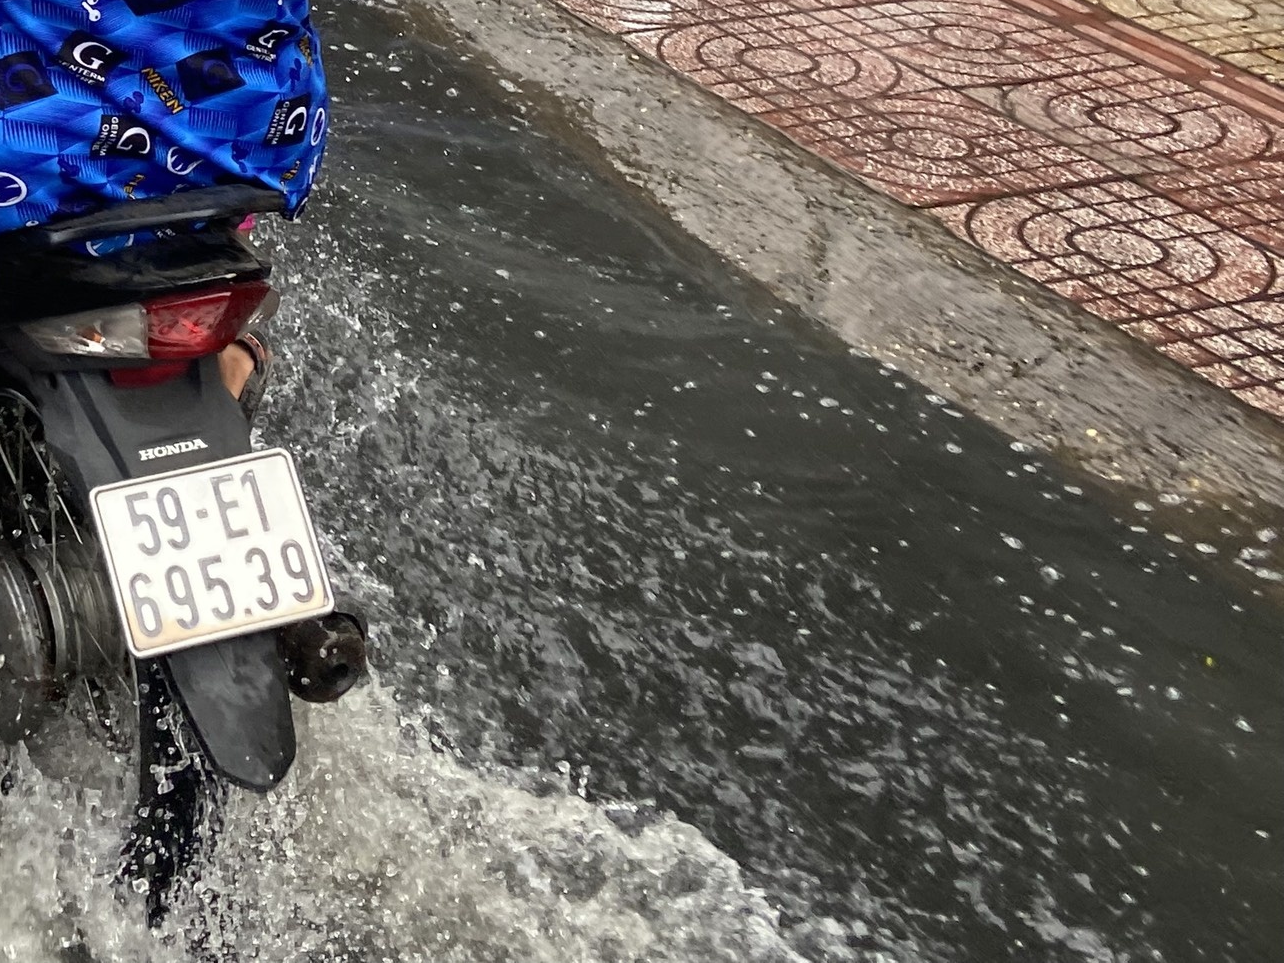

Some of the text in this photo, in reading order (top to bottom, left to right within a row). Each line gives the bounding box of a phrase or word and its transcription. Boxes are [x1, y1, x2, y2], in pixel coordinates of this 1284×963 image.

[72, 41, 113, 70] G
[141, 67, 184, 115] NIKEN
[284, 106, 307, 136] G
[138, 438, 208, 461] HONDA
[124, 469, 271, 556] 59-E1
[129, 539, 315, 638] 695.39
